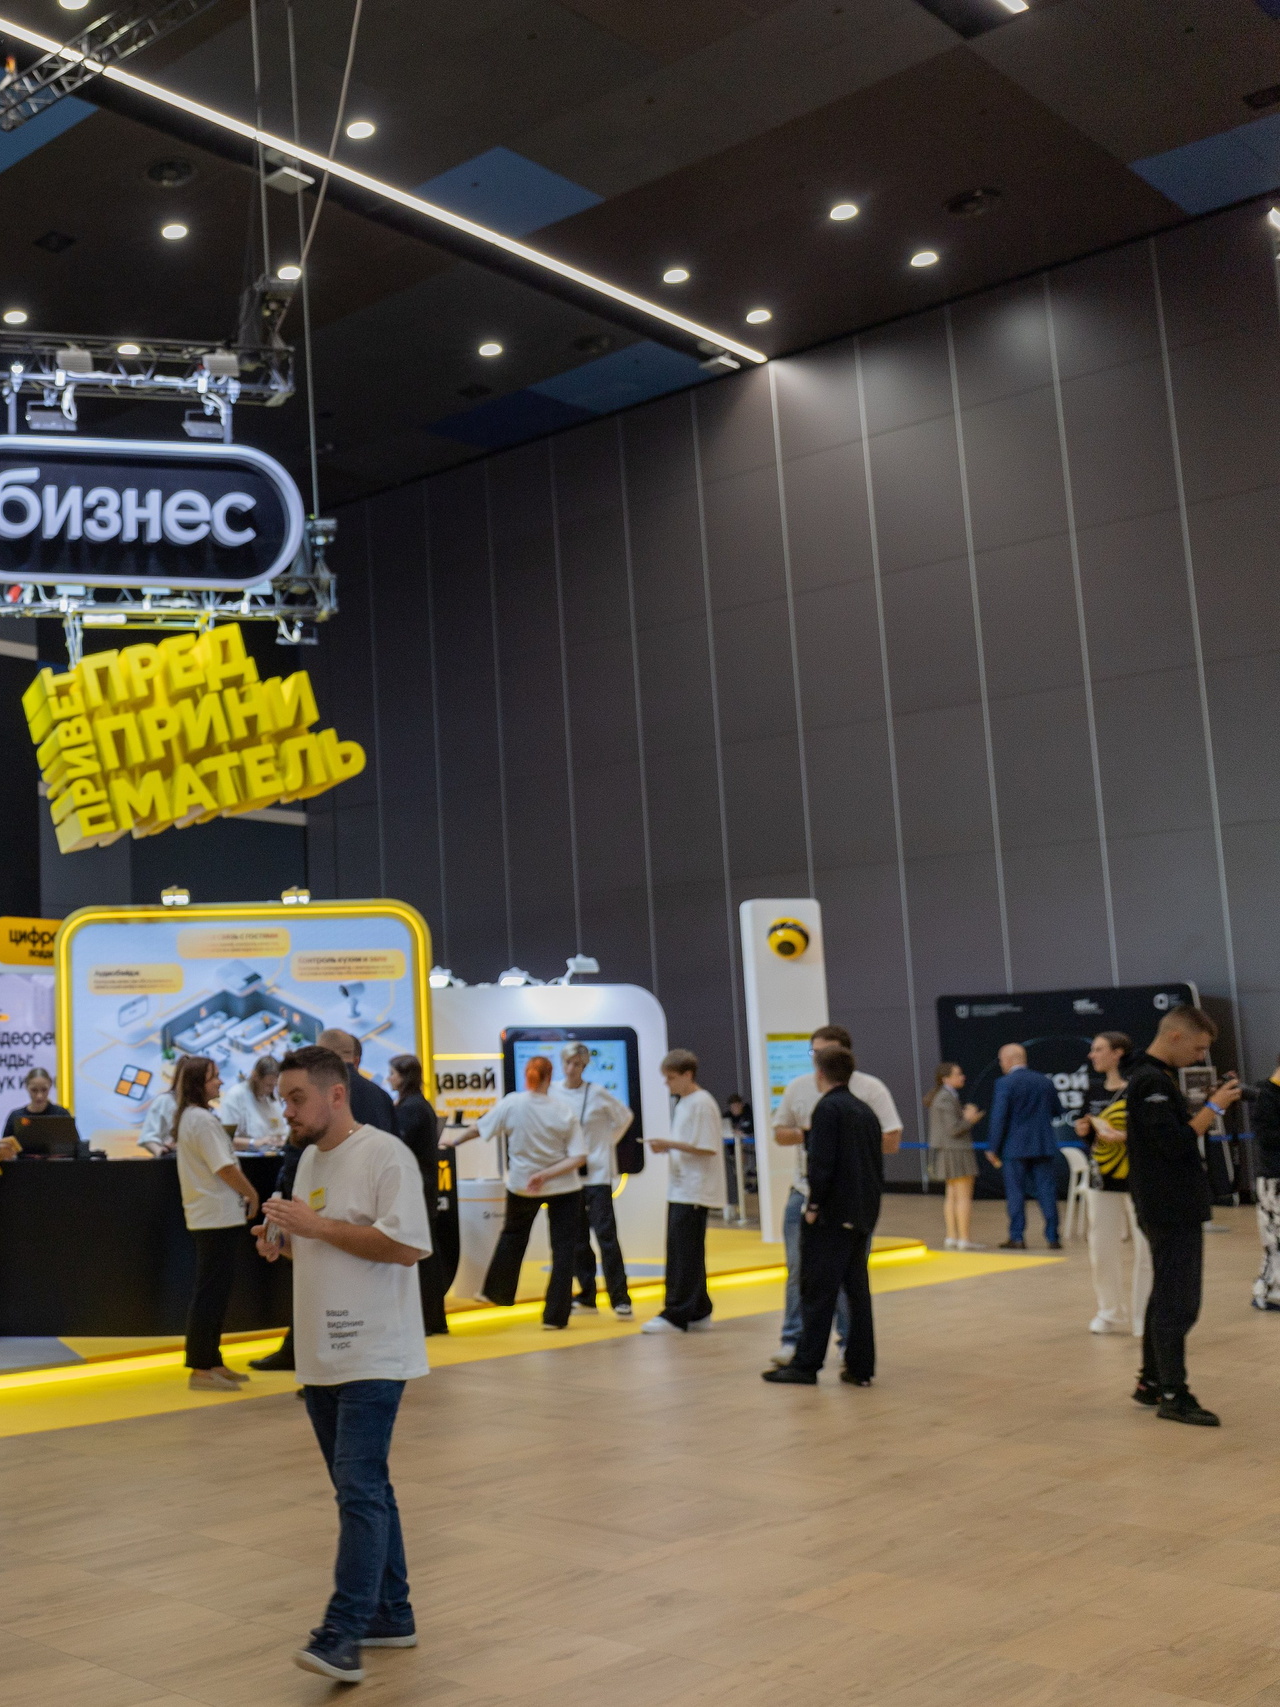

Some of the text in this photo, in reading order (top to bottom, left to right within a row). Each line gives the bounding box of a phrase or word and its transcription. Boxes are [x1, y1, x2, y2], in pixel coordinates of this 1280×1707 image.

[80, 622, 259, 708] ПРЕД
[40, 667, 117, 840] ПРИВЕТ
[95, 670, 320, 771] ПРИНИ
[109, 728, 366, 831] МАТЕЛЬ
